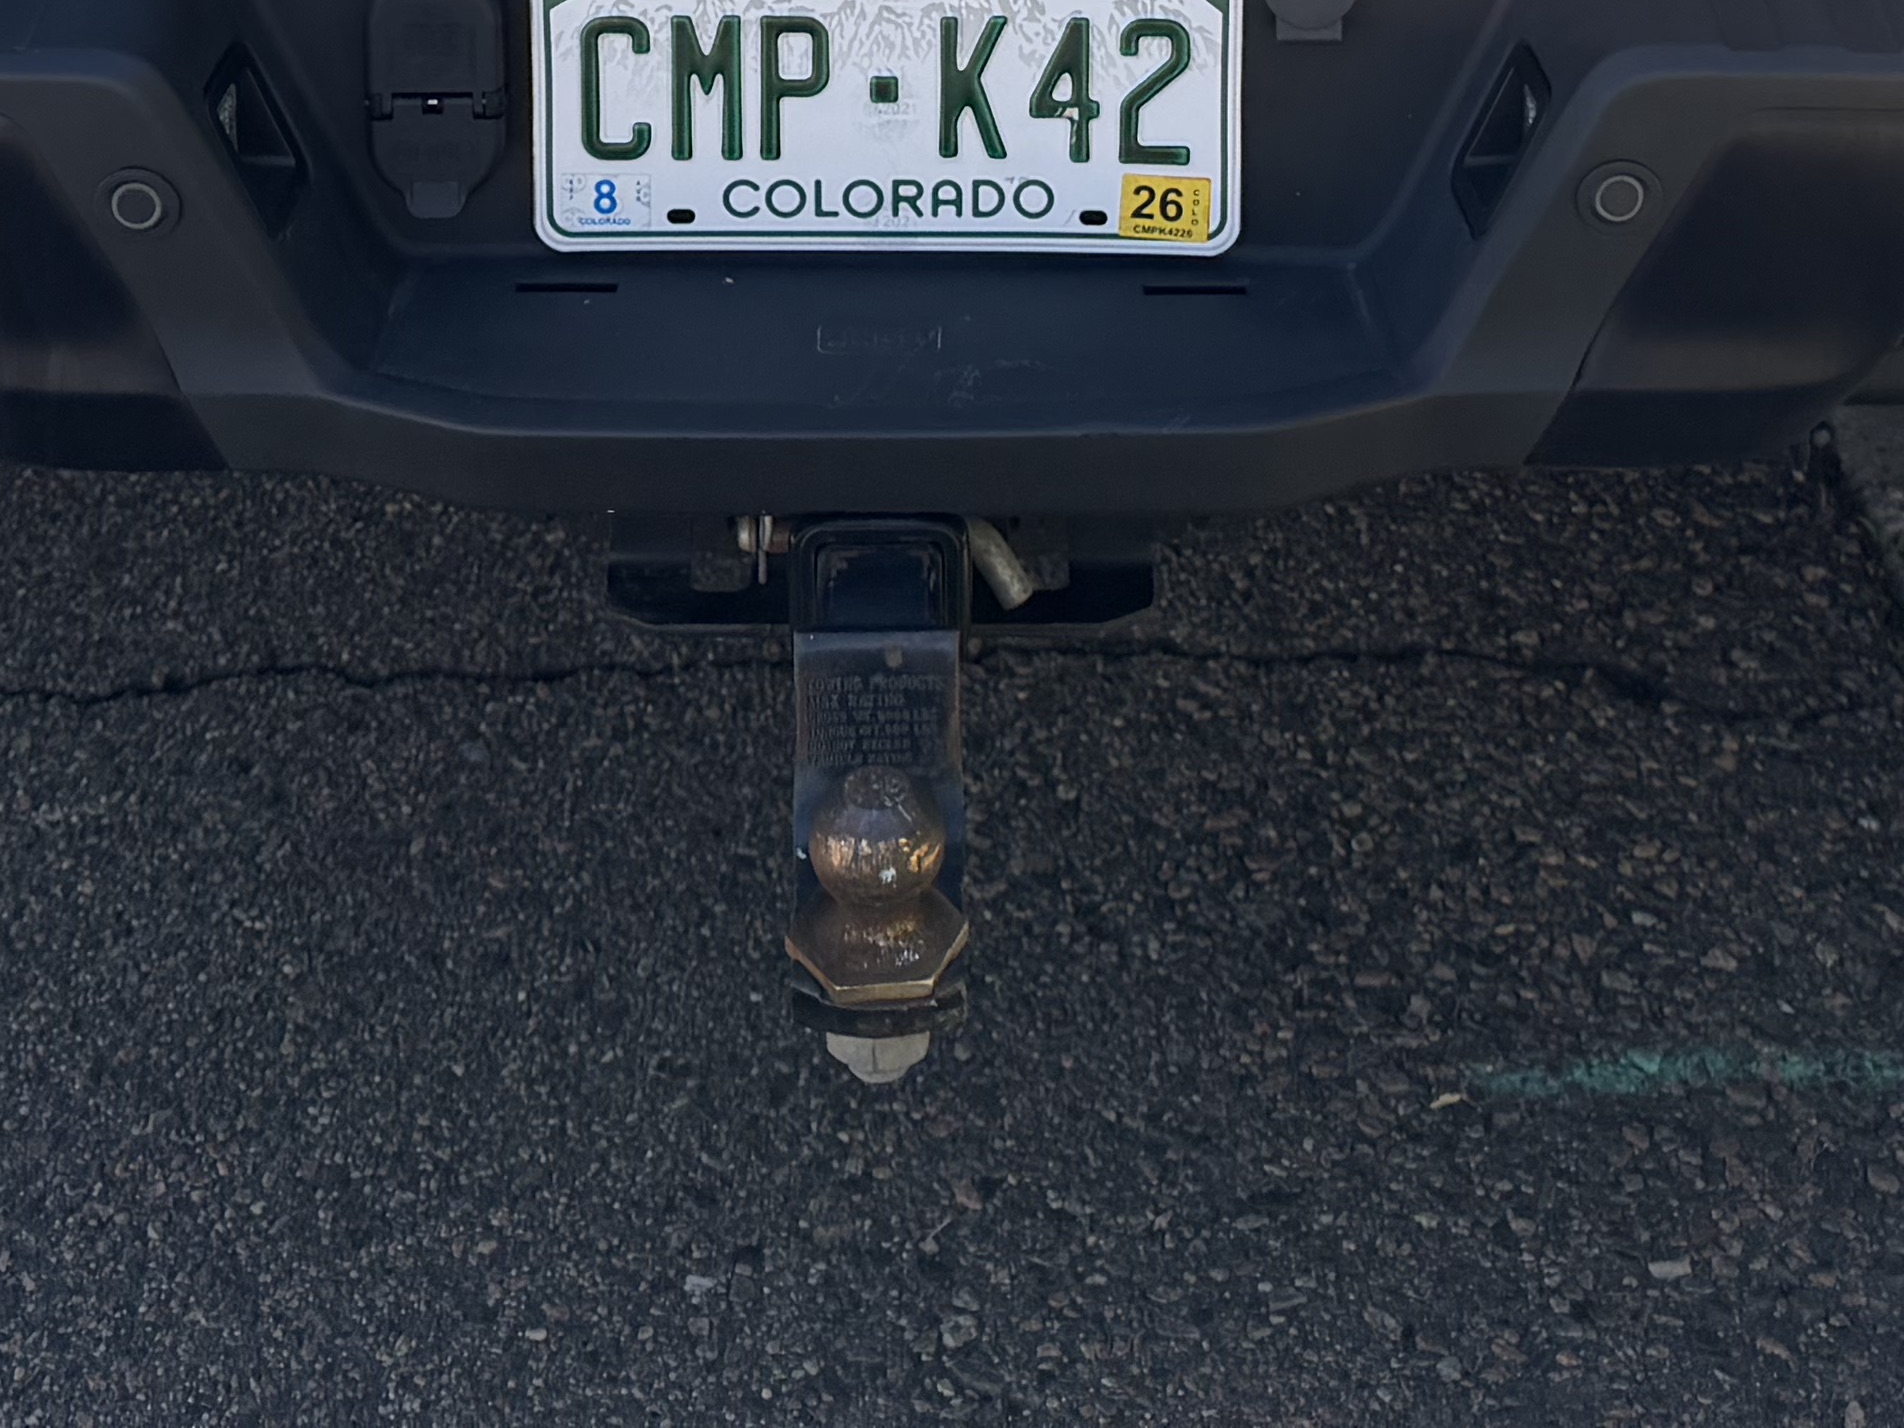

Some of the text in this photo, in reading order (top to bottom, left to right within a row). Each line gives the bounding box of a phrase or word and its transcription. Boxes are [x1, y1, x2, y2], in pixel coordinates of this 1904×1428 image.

[594, 179, 618, 215] 8
[722, 179, 1054, 219] COLORADO
[1130, 185, 1184, 223] 26
[869, 674, 945, 691] PRODUCTS
